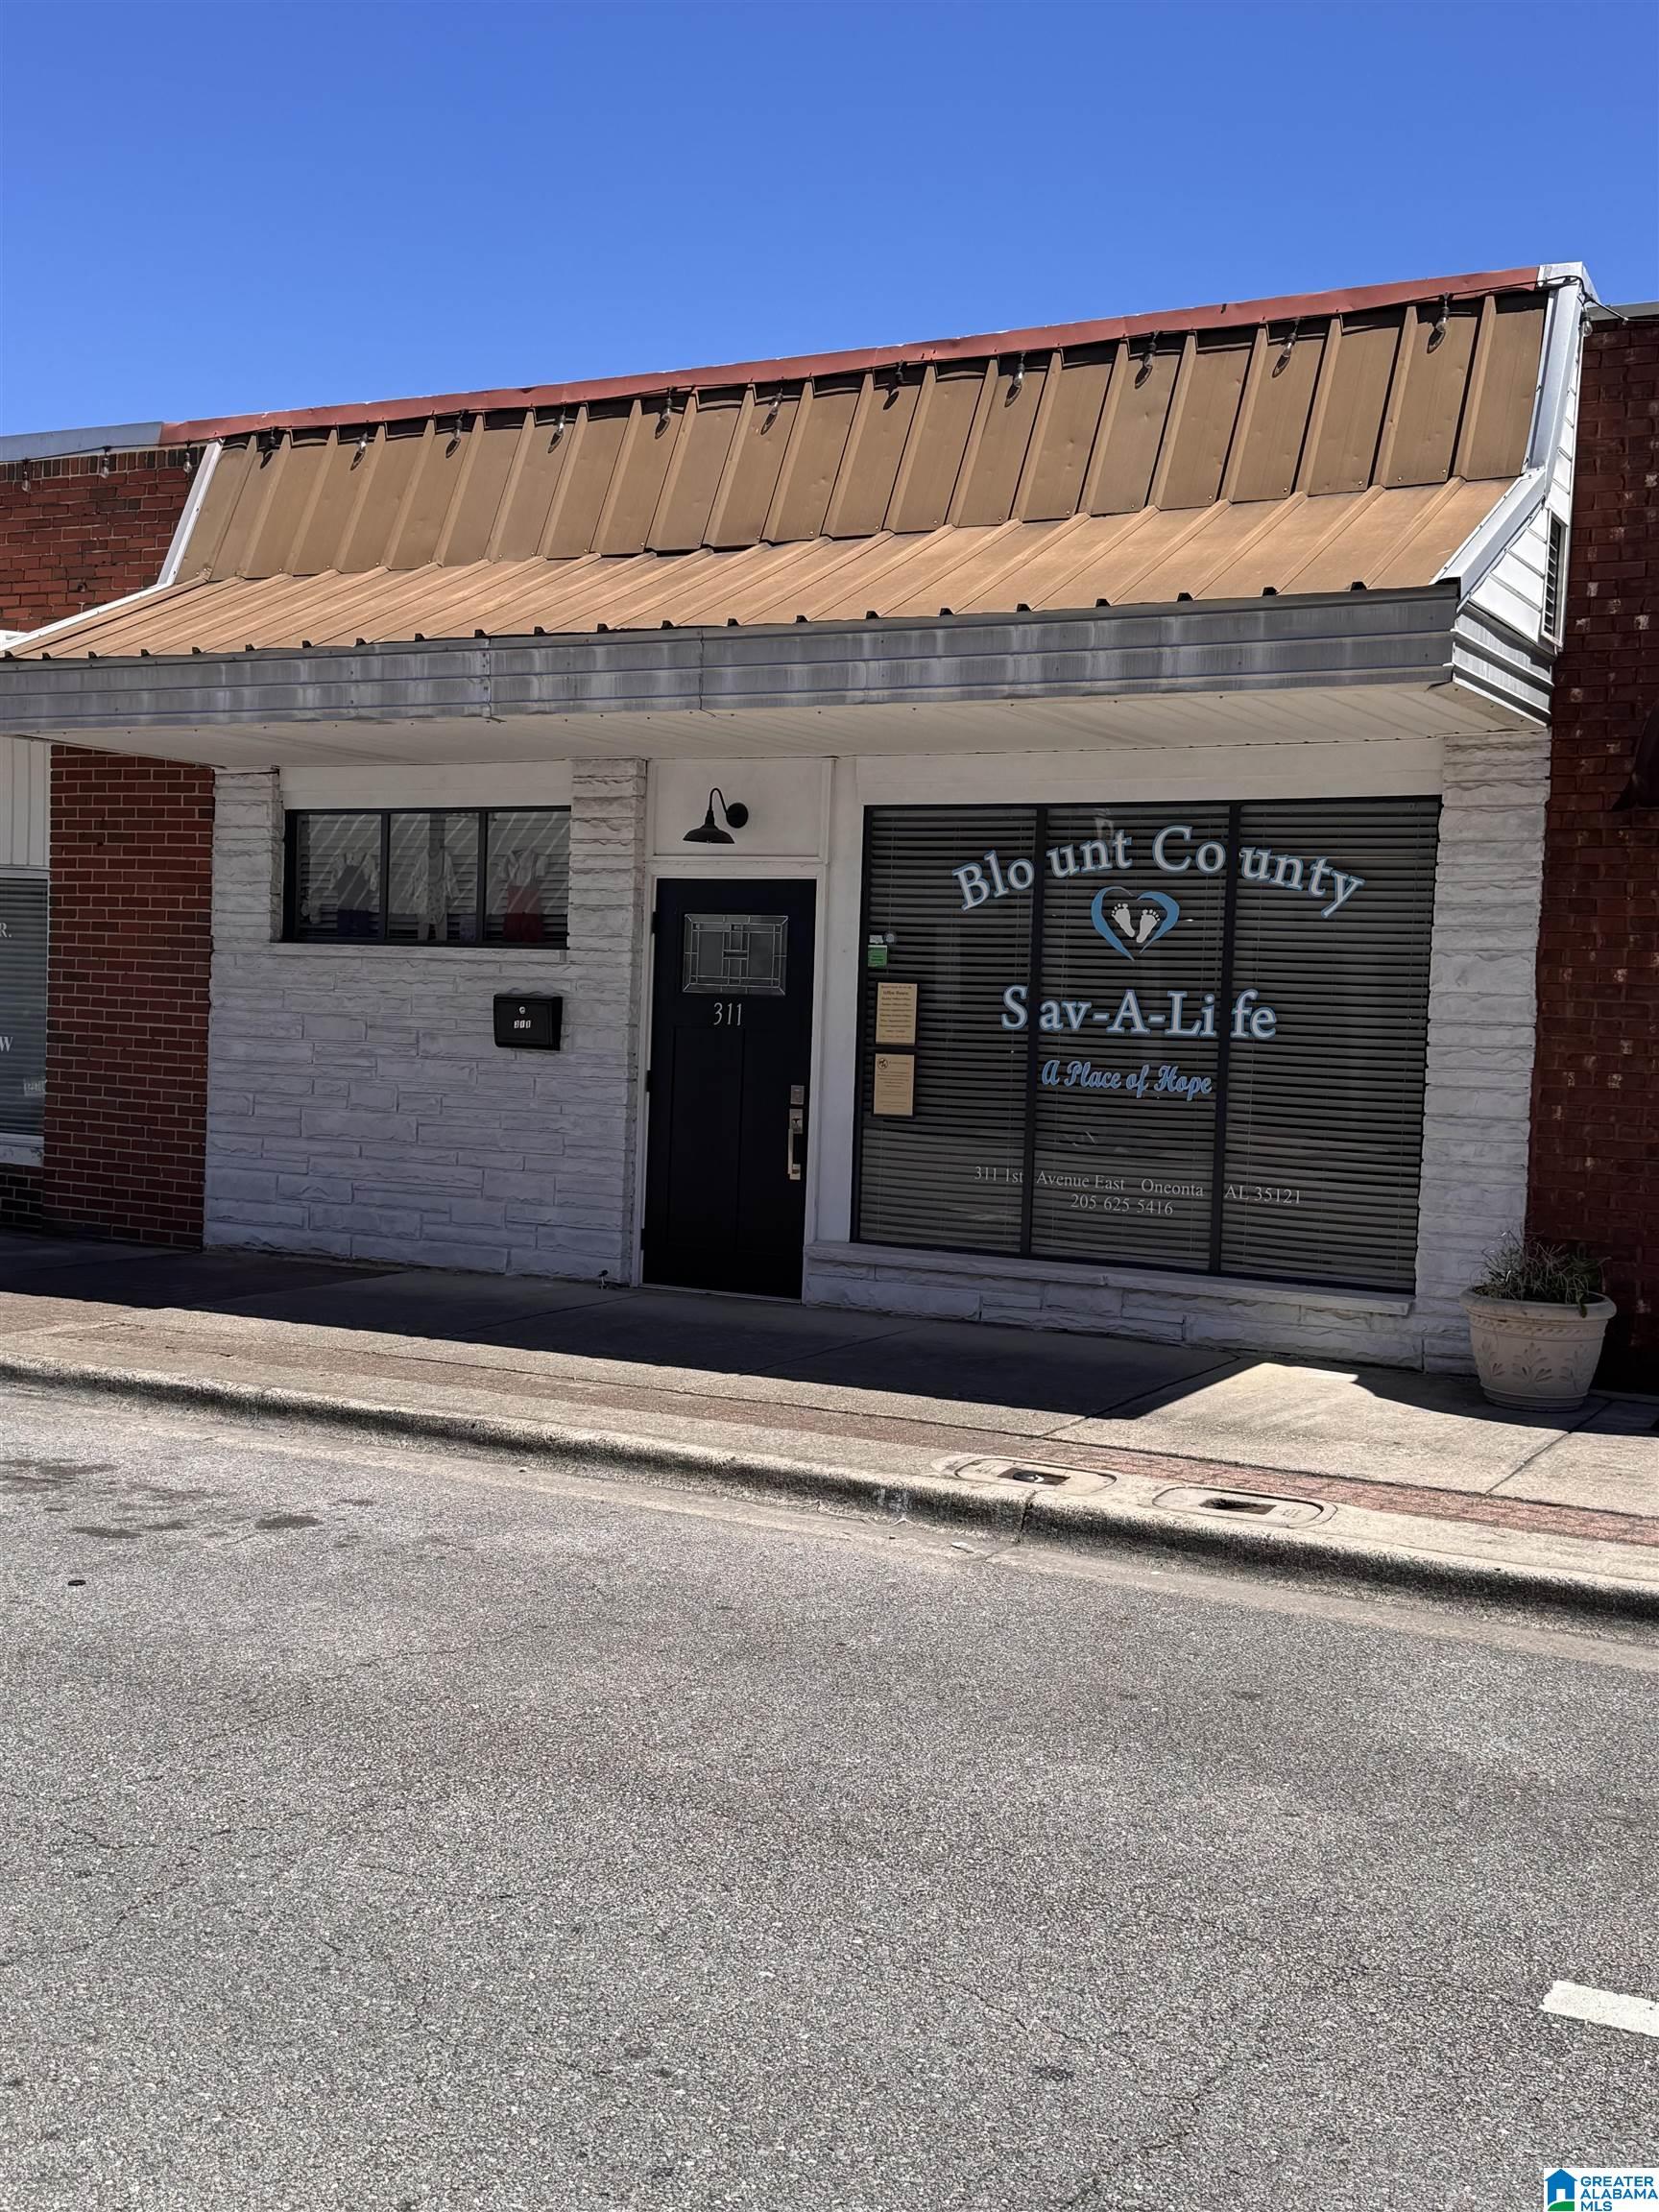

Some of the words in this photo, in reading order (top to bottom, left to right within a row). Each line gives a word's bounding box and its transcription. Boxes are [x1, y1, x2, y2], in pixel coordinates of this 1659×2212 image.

[951, 828, 1133, 911] Blount
[1152, 825, 1366, 919] County
[713, 1002, 742, 1026] 311
[1000, 984, 1277, 1039] Sav-A-Life
[1041, 1059, 1061, 1086] A
[1064, 1060, 1122, 1089] Place
[1125, 1064, 1149, 1098] of
[1153, 1064, 1213, 1101] Hope
[974, 1166, 998, 1181] 311
[1005, 1167, 1024, 1183] 1st
[1036, 1170, 1090, 1188] Avenue
[1094, 1174, 1125, 1190] East
[1141, 1178, 1204, 1197] Oneonta
[1224, 1185, 1249, 1200] AL
[1254, 1186, 1300, 1204] 35121
[1070, 1193, 1097, 1210] 205
[1104, 1196, 1130, 1213] 625
[1136, 1199, 1173, 1215] 5416
